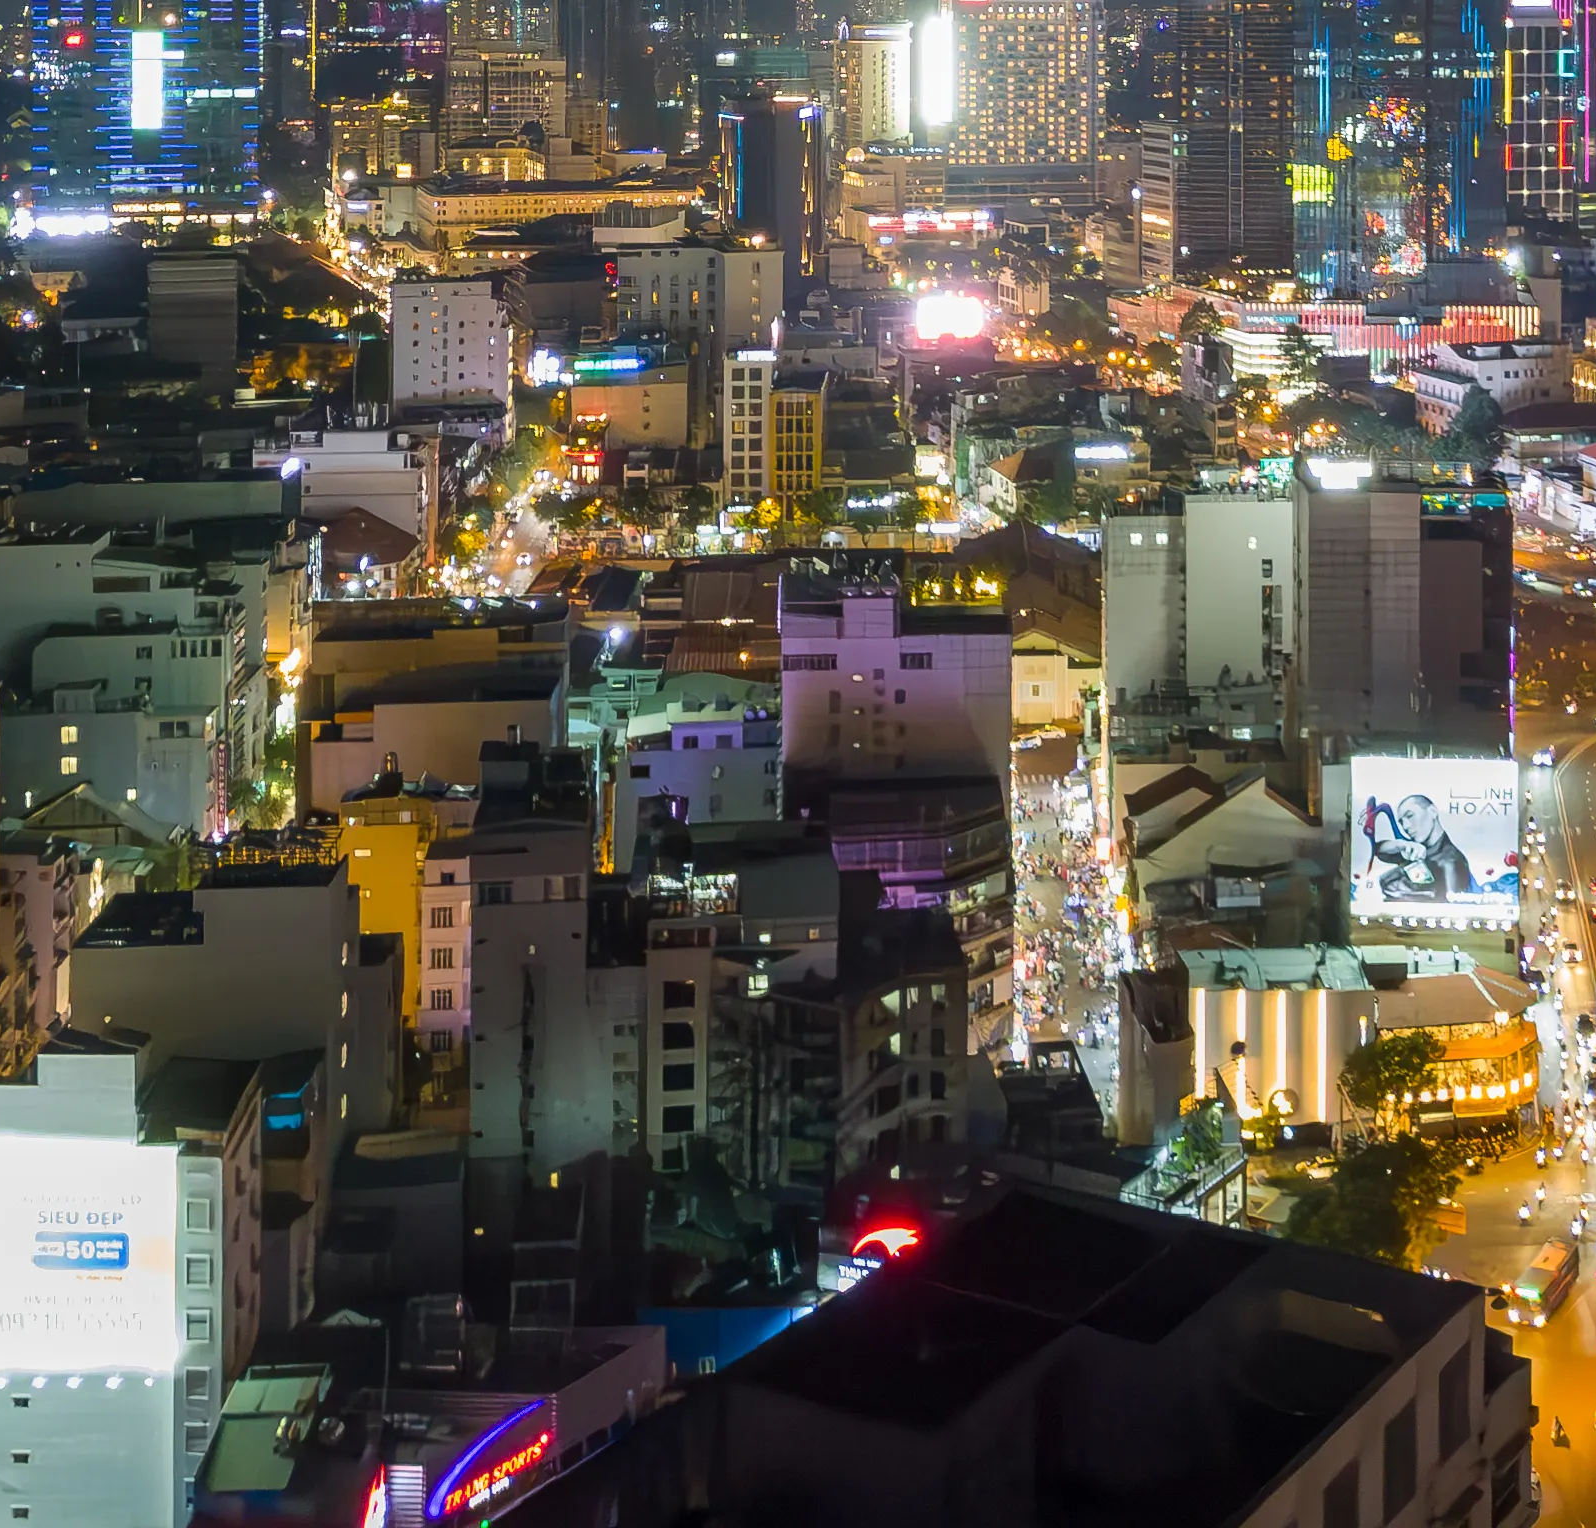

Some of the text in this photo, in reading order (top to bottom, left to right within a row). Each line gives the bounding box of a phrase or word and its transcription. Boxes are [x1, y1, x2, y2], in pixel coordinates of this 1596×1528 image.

[1450, 787, 1513, 800] LINH
[66, 1240, 96, 1260] 50
[445, 1473, 490, 1511] TRANG
[492, 1442, 543, 1482] SPORTS
